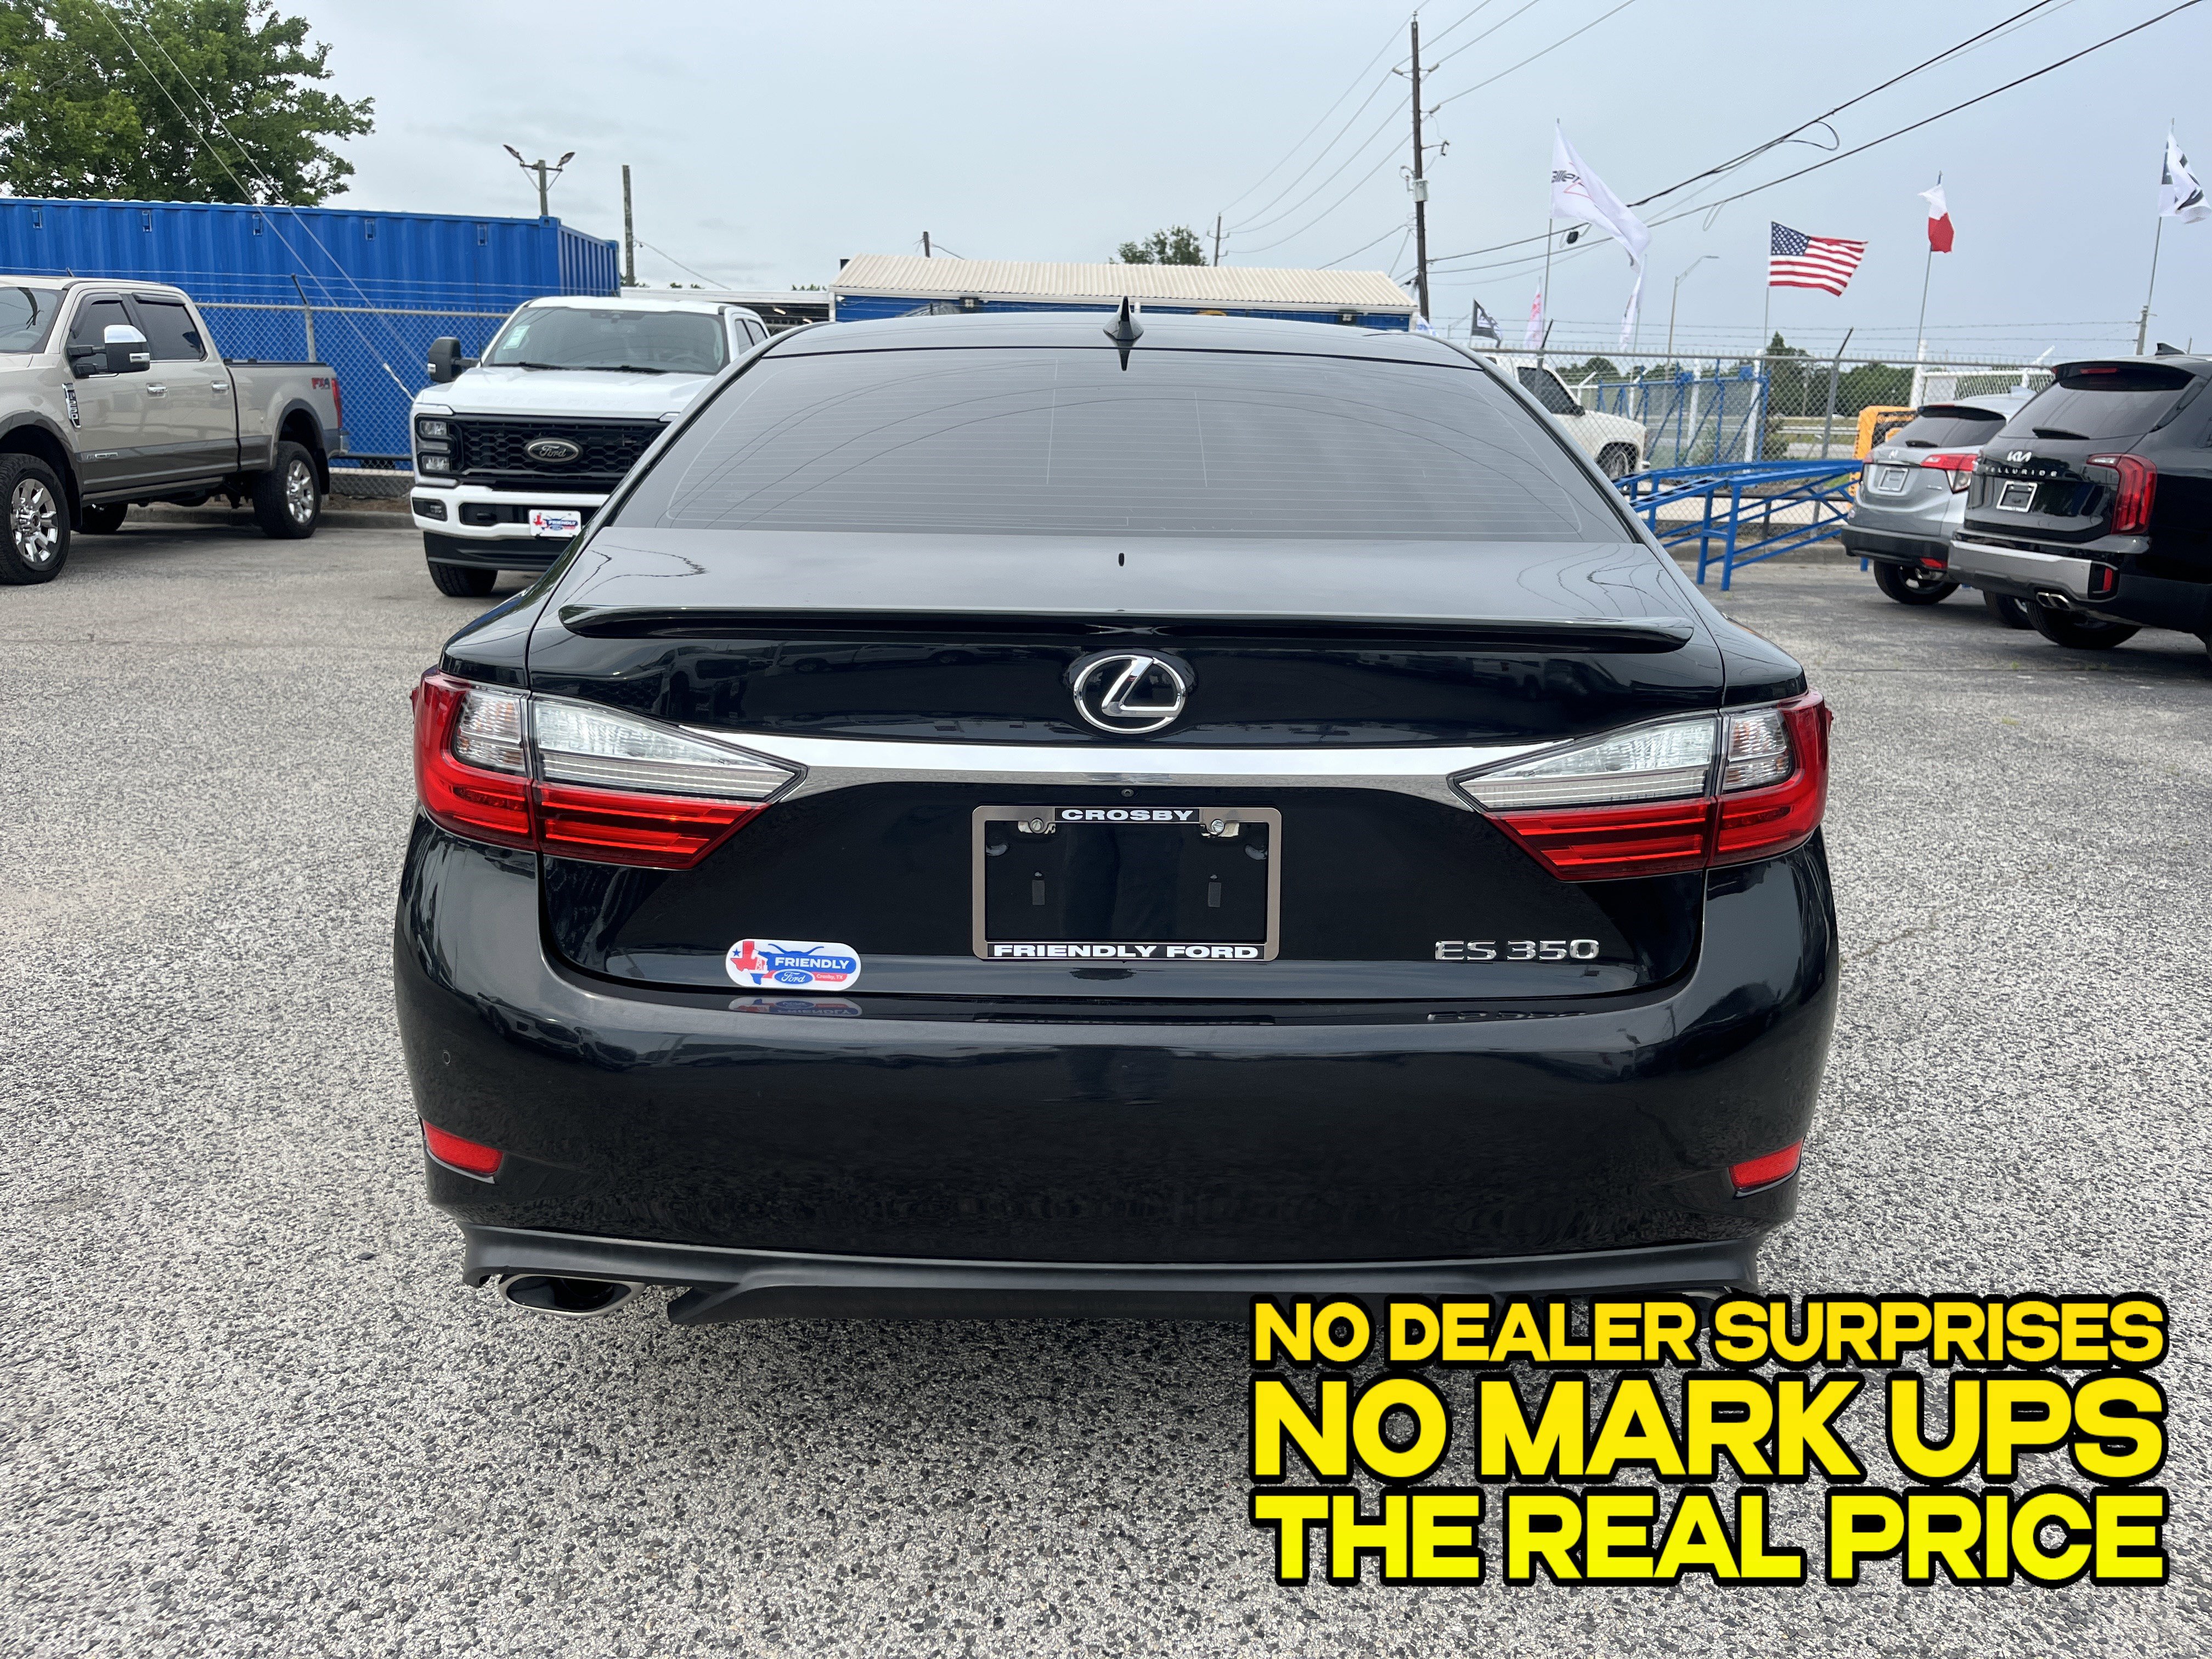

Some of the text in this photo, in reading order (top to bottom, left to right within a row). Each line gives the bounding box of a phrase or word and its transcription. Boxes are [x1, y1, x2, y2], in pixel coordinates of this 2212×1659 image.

[539, 445, 567, 458] Ford
[1062, 809, 1193, 821] CROSBY
[994, 944, 1259, 959] FRIENDLY FORD
[1435, 939, 1600, 960] ES 350
[775, 957, 850, 969] FRIENDLY
[781, 972, 806, 983] Ford
